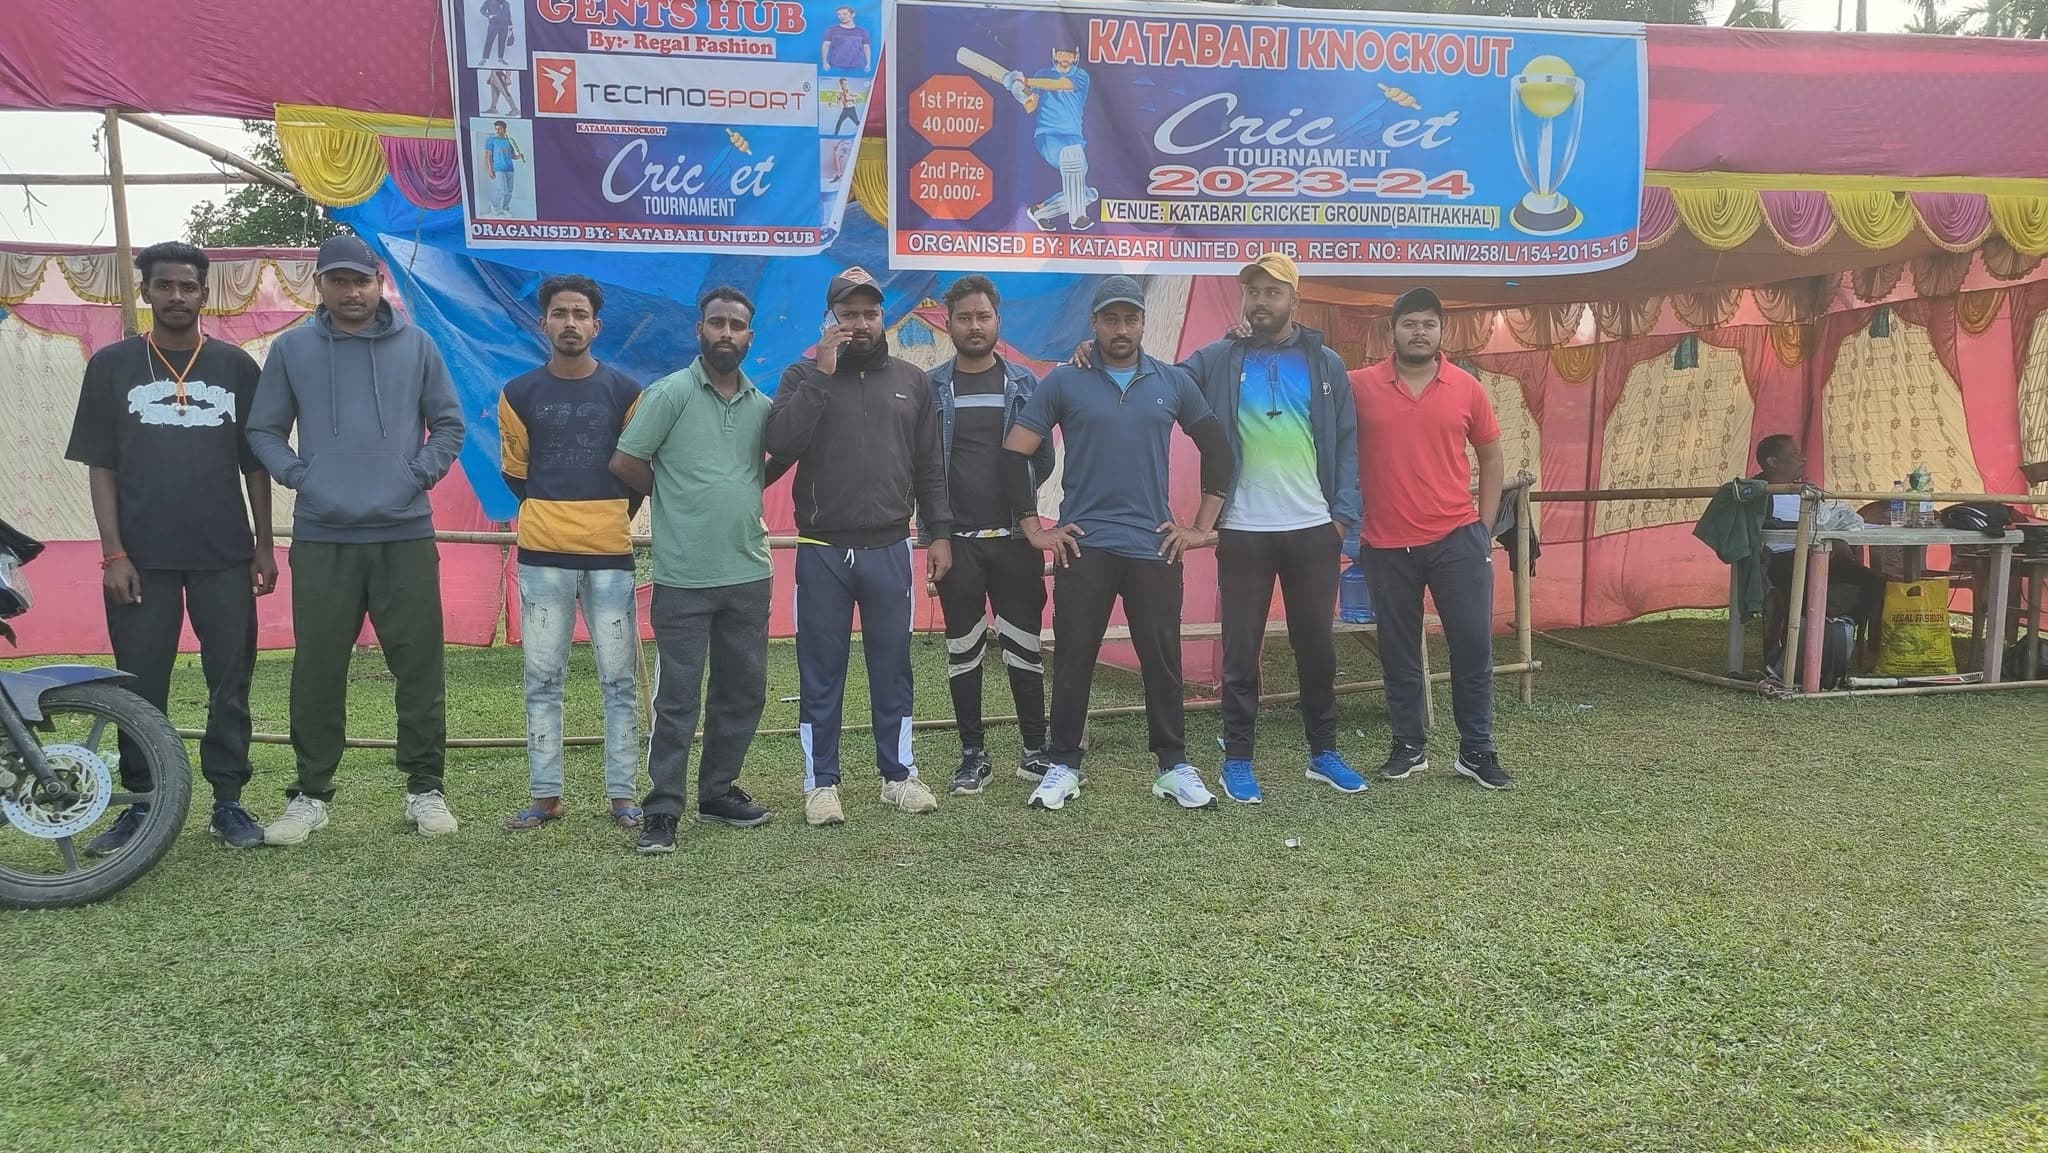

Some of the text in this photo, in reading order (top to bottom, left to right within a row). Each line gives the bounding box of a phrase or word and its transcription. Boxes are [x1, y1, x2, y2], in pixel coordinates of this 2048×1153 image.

[537, 0, 806, 33] GENTS HUB
[589, 31, 774, 56] By:- Regal Fashion
[1088, 19, 1514, 77] KATABARI KNOCKOUT
[919, 90, 984, 110] 1st Prize
[576, 123, 667, 136] KATABARI KNOCKOUT
[922, 116, 985, 135] 40,000/-
[1224, 148, 1391, 168] TOURNAMENT
[920, 161, 985, 180] 2nd Prize
[1147, 165, 1474, 198] 2023-24
[920, 184, 982, 202] 20,000/-
[643, 195, 737, 217] TOURNAMENT
[1107, 202, 1164, 221] VENUE:
[1169, 204, 1247, 222] KATABARI
[1251, 205, 1320, 223] CRICKET
[471, 223, 581, 239] ORAGANISED
[618, 228, 704, 242] KATABARI
[708, 230, 769, 244] UNITED
[773, 231, 815, 244] CLUB
[908, 233, 1026, 255] ORGANISED
[1032, 237, 1064, 255] BY:
[1069, 238, 1164, 258] KATABARI
[1169, 241, 1239, 259] UNITED
[1308, 242, 1362, 261] REGT.
[1369, 243, 1401, 261] NO:
[1407, 236, 1629, 263] KARIM/258/L/154-2015-16
